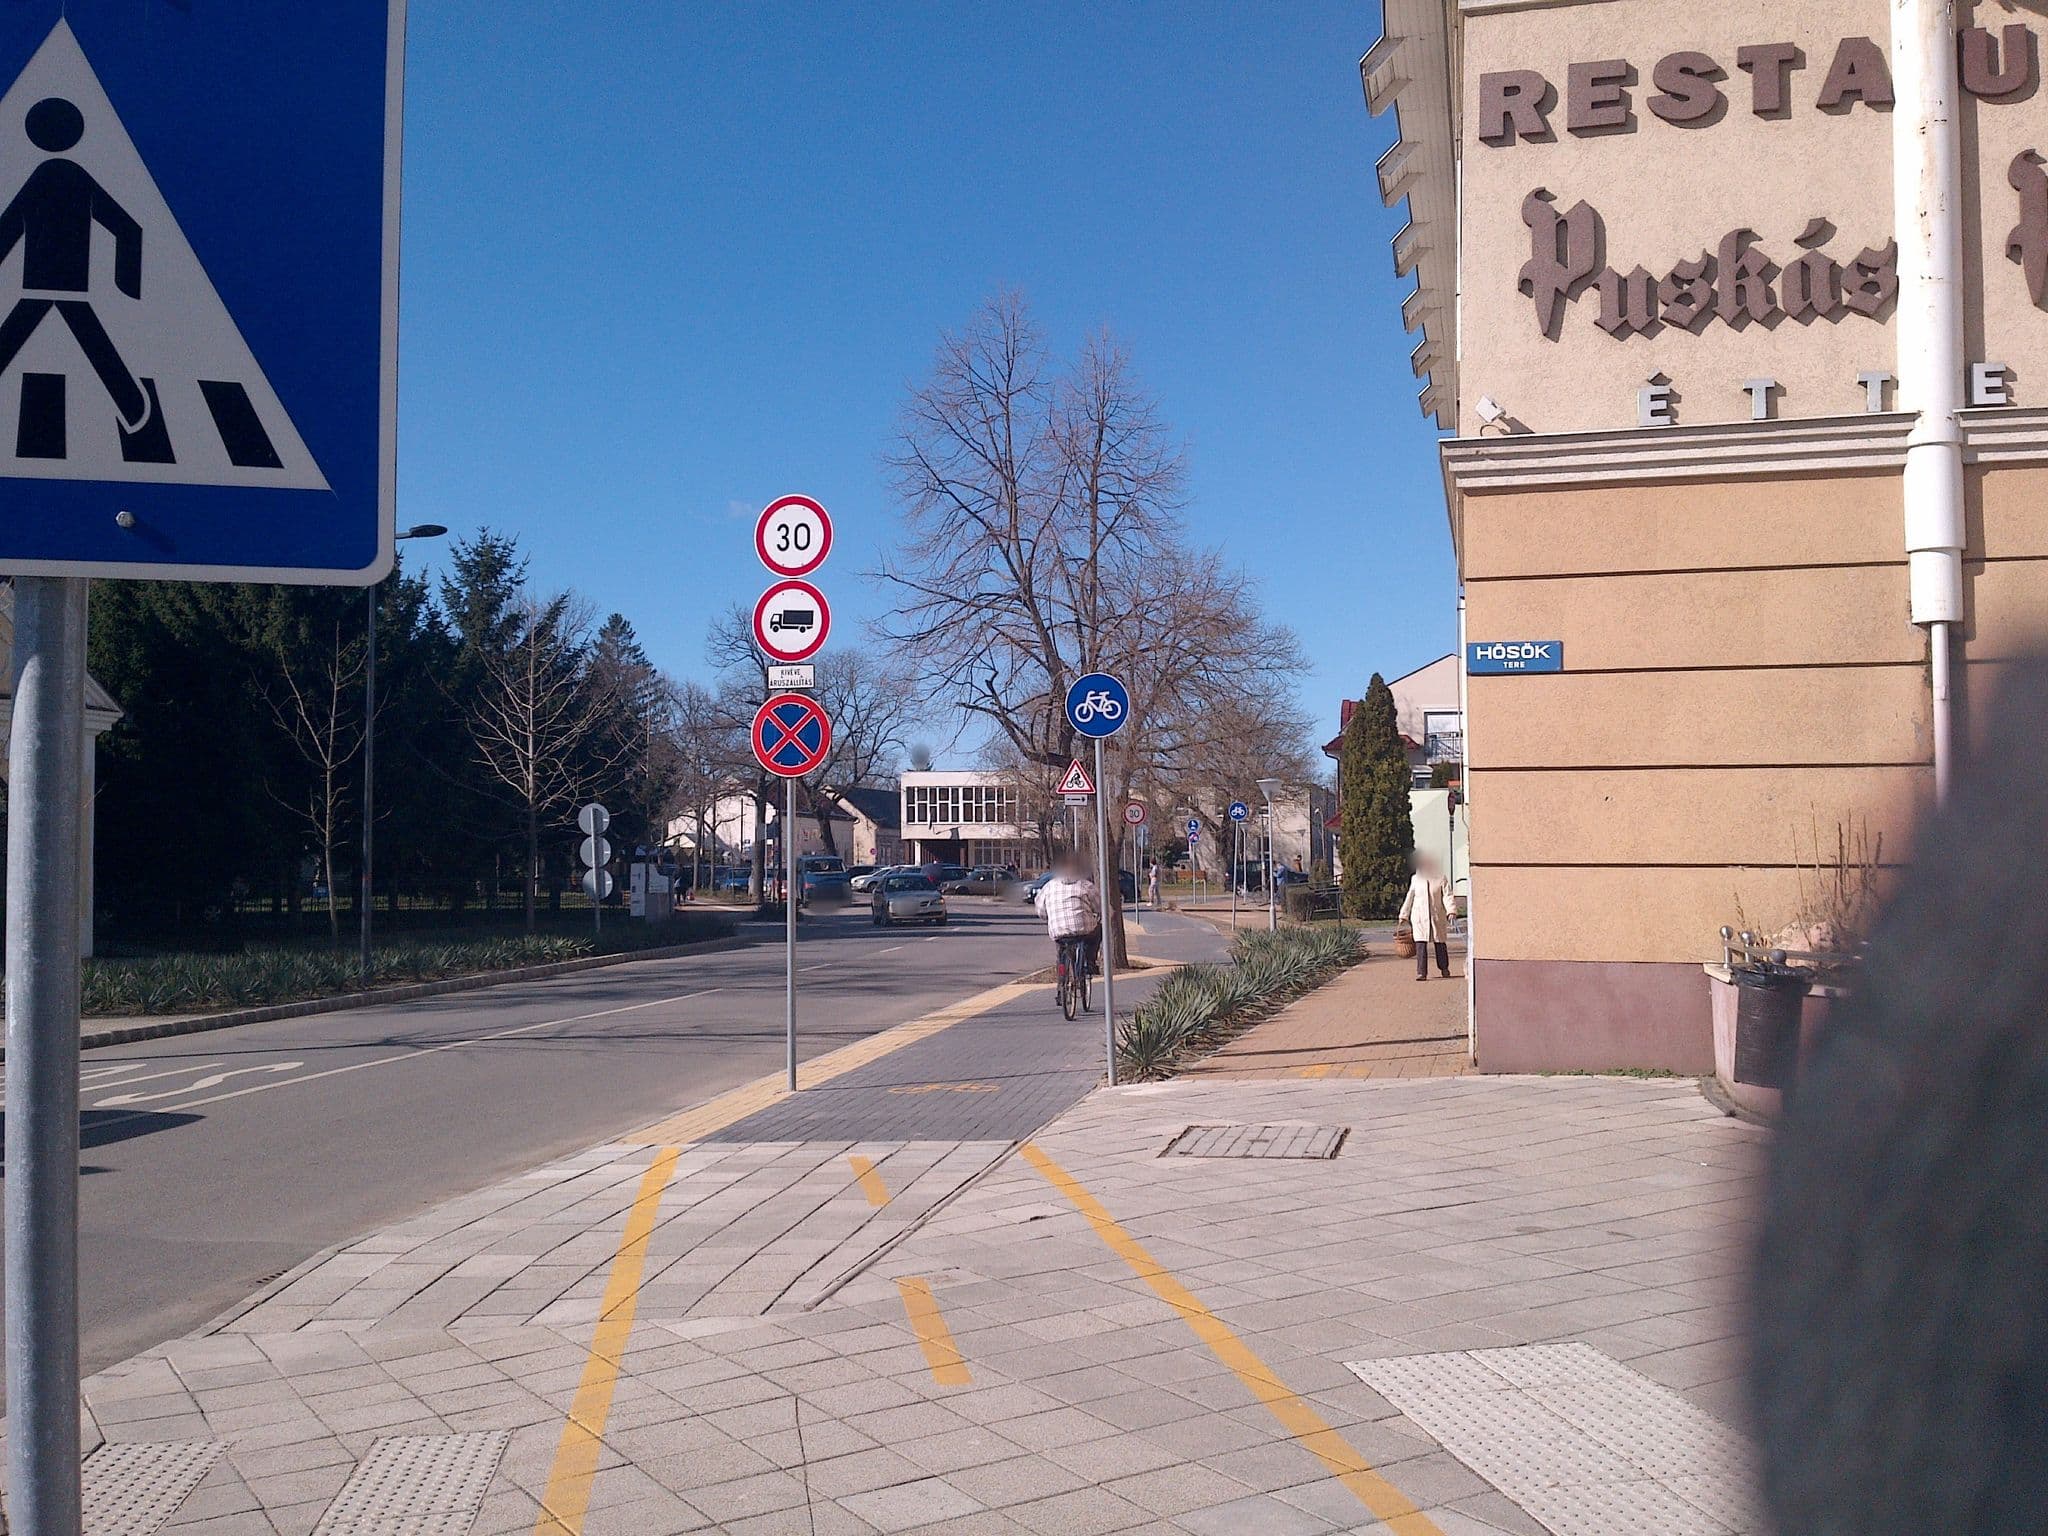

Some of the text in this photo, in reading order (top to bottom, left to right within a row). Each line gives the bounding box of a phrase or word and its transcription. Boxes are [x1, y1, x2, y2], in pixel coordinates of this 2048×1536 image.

[1517, 186, 1900, 336] Puskás
[776, 522, 811, 551] 30
[1503, 661, 1526, 669] TERE
